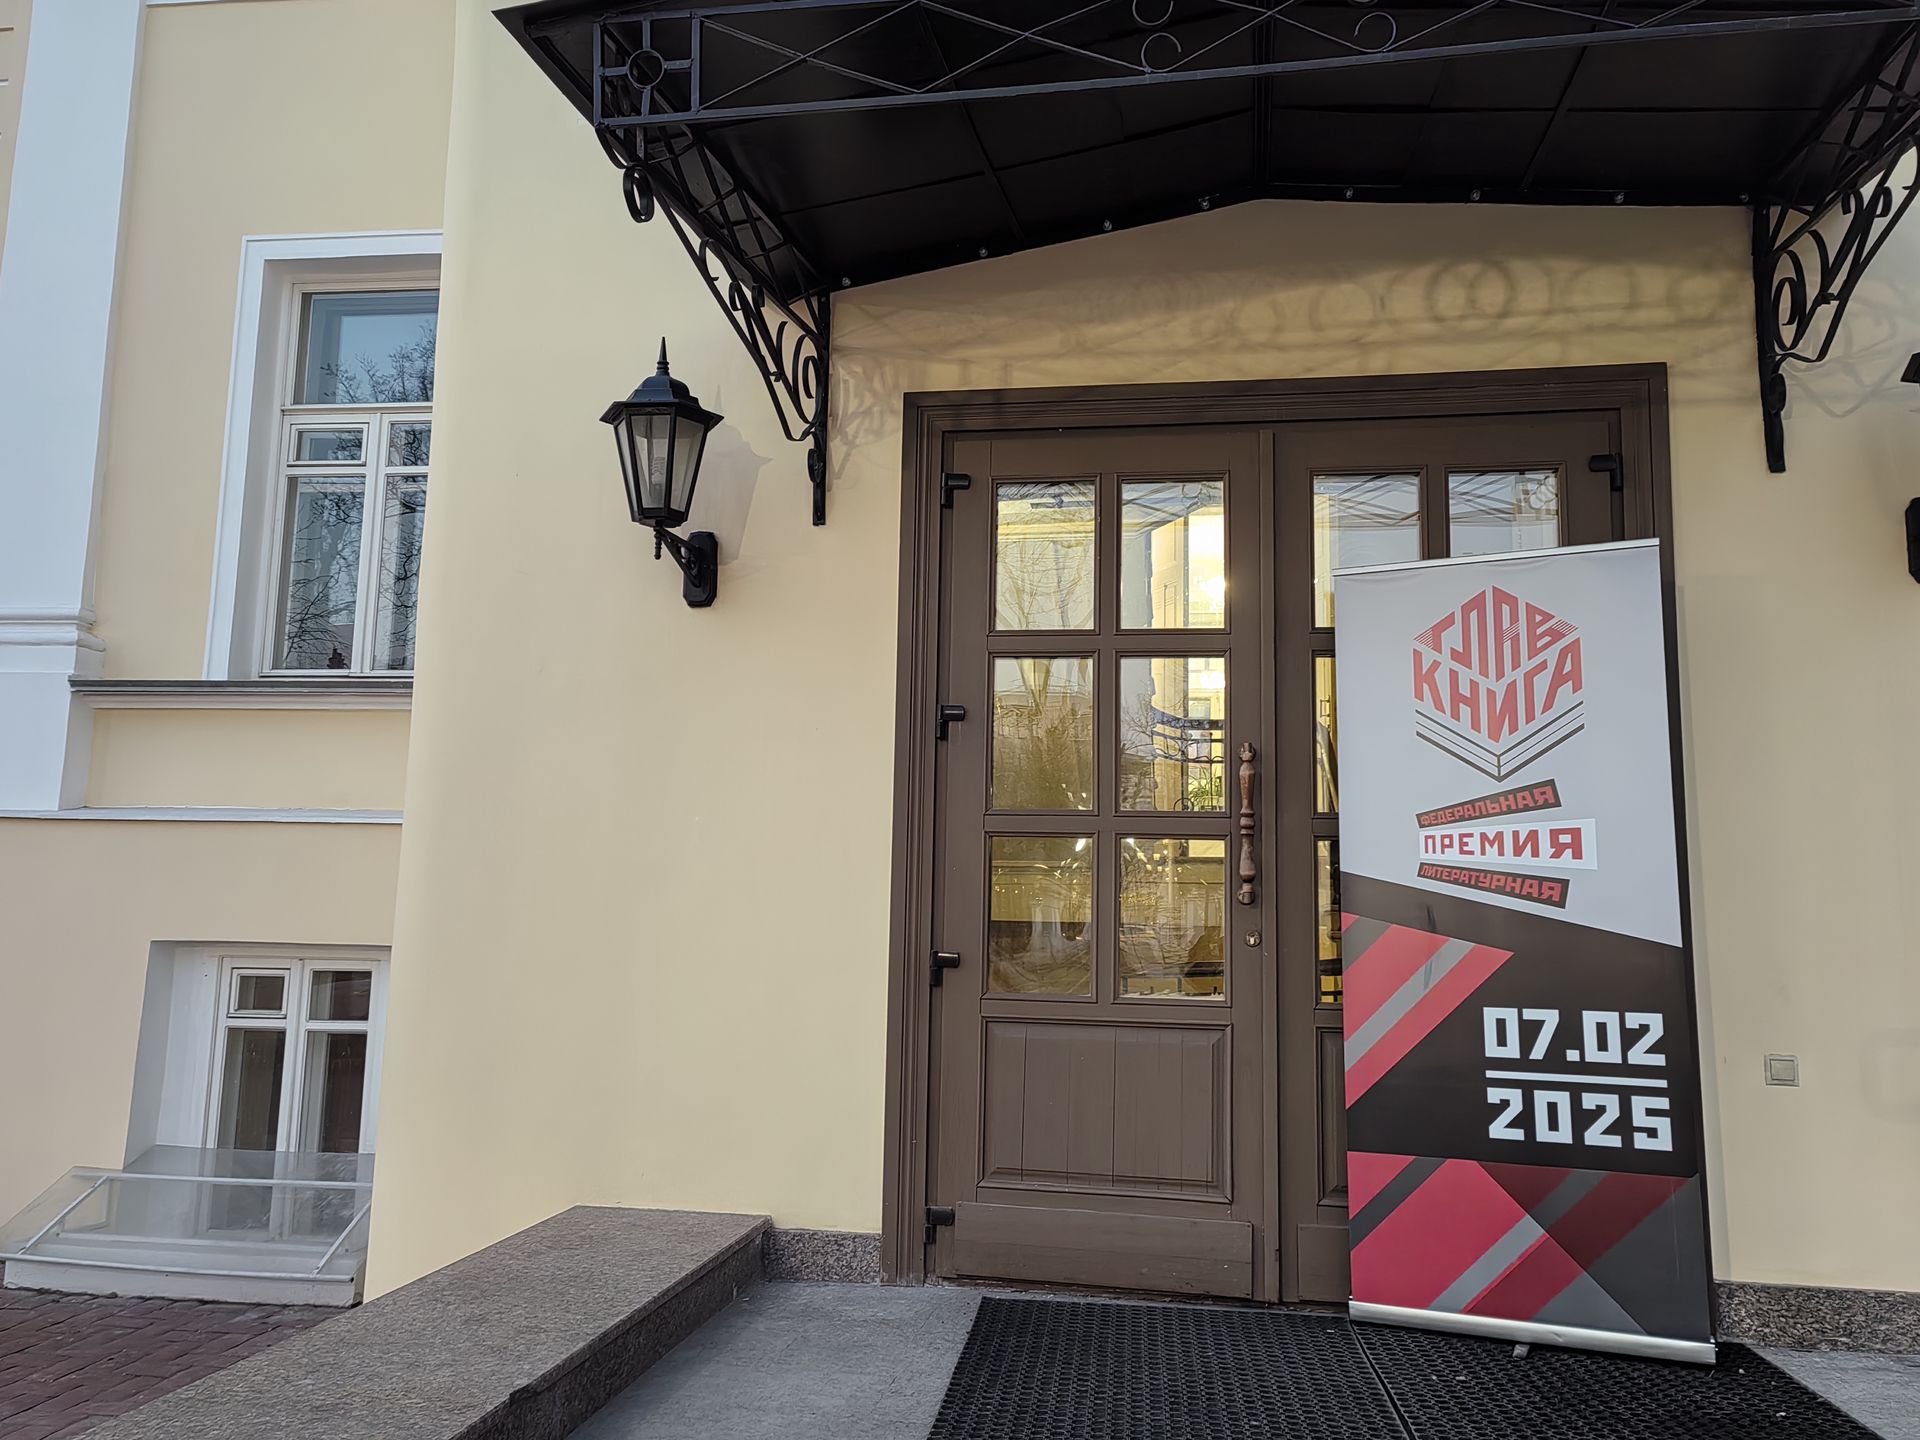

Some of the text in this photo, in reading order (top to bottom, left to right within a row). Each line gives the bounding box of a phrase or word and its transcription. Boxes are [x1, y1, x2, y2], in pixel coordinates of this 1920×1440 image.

[1413, 585, 1579, 683] ГЛАВ
[1413, 636, 1583, 743] КНИГА
[1420, 785, 1556, 826] ФЕДЕРАЛЬНАЯ
[1424, 827, 1583, 860] ПРЕМИЯ
[1420, 865, 1563, 902] ЛИТЕРАТУРНАЯ
[1483, 1007, 1666, 1066] 07.02
[1486, 1087, 1673, 1152] 2025
